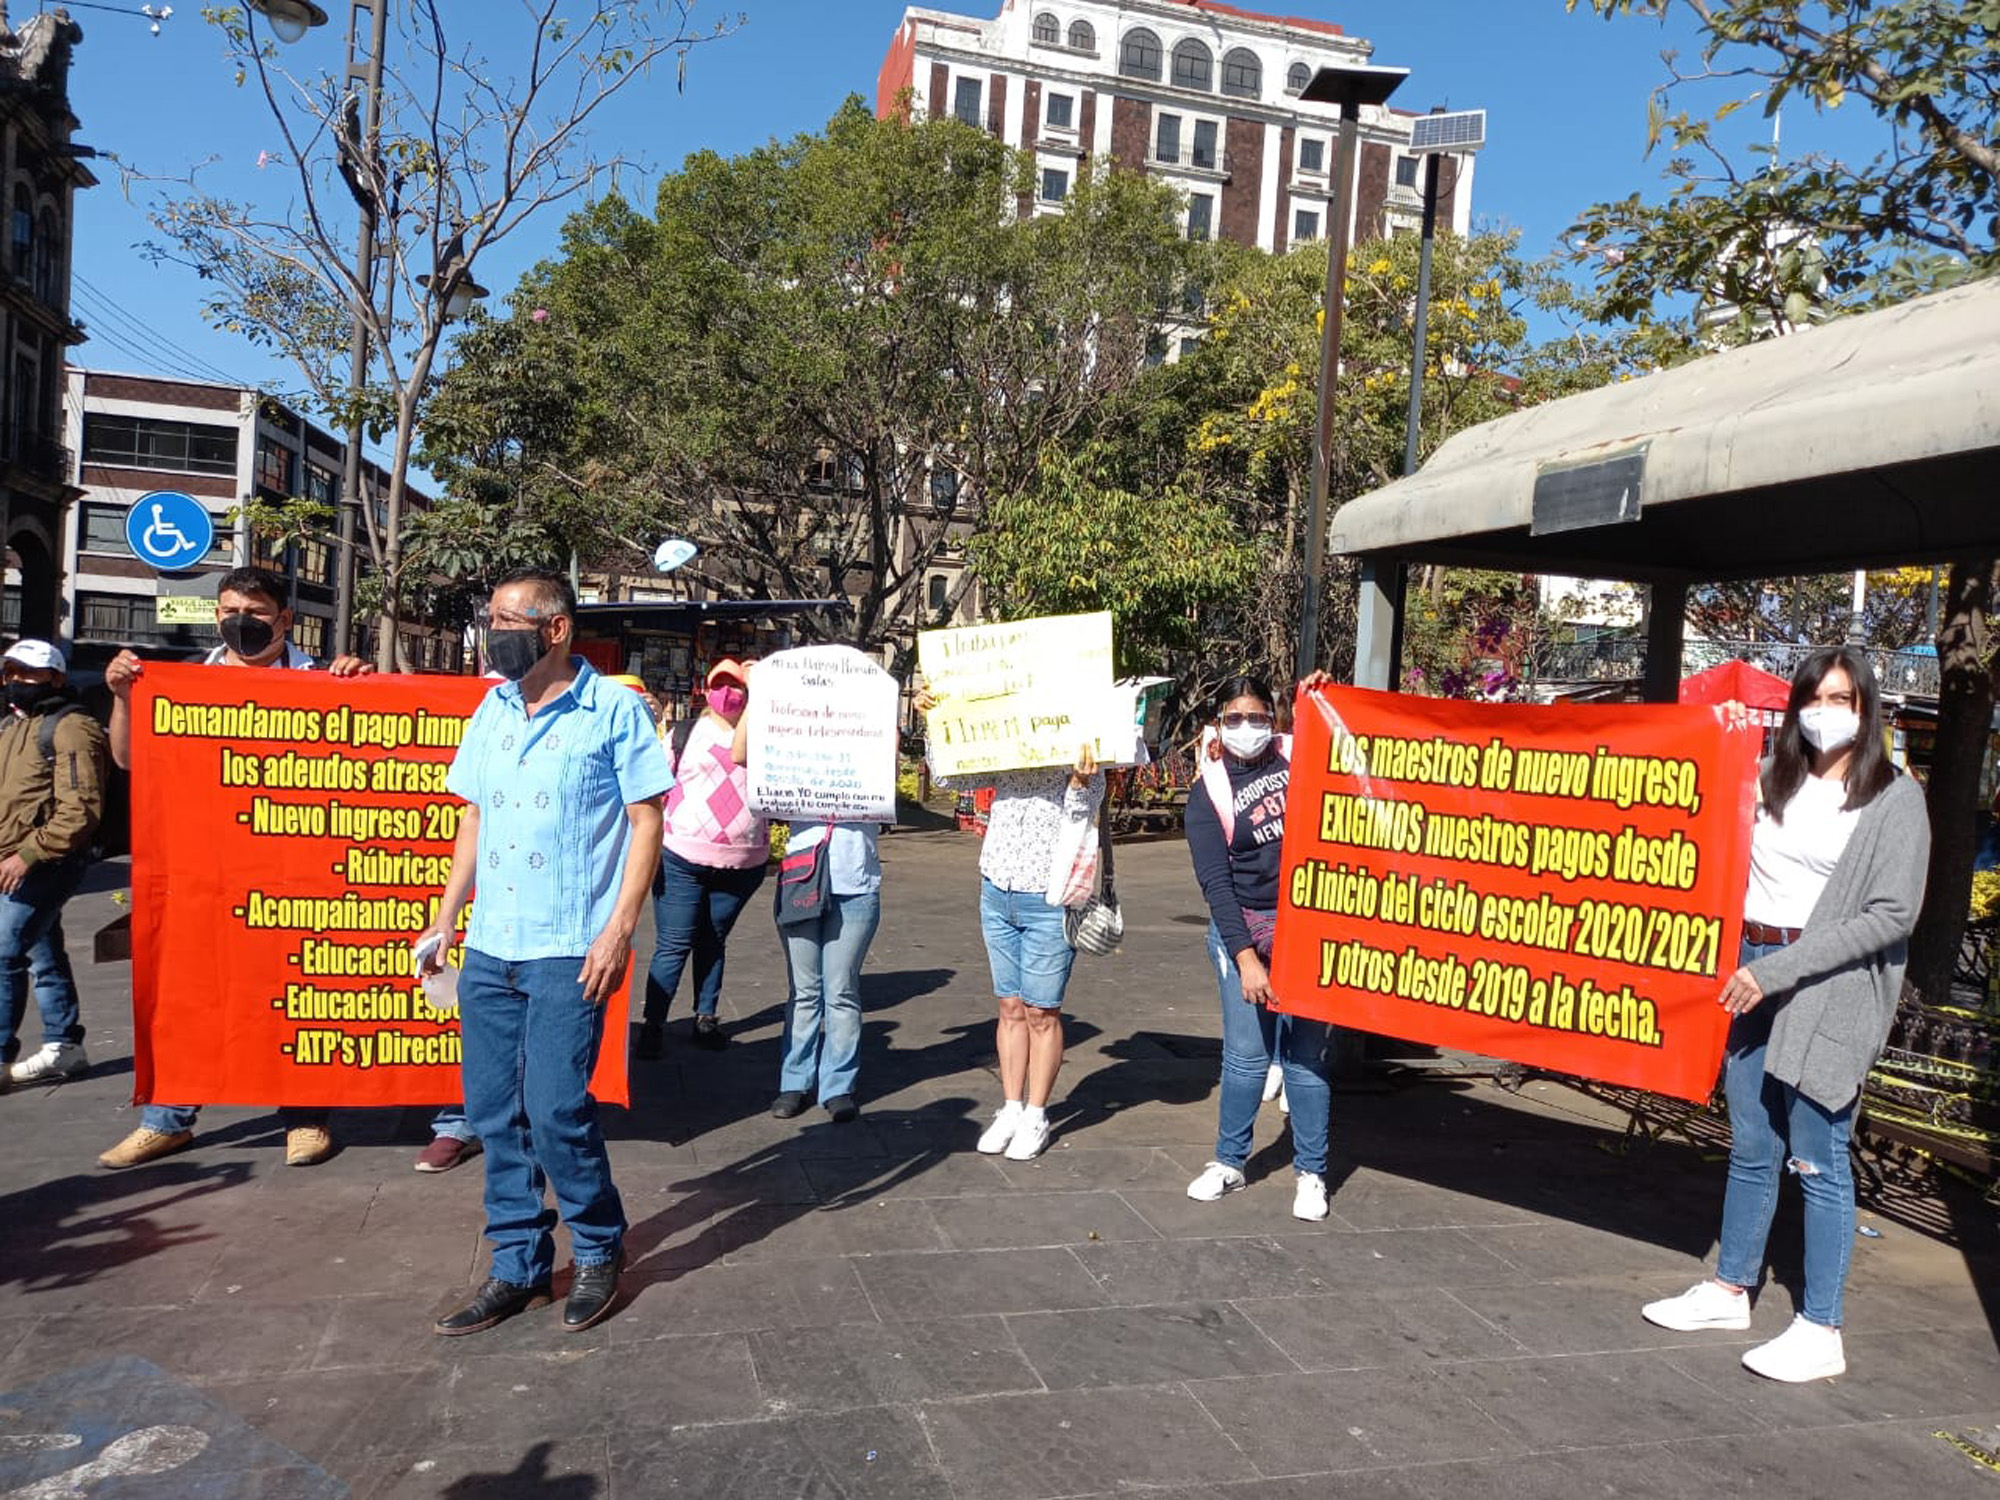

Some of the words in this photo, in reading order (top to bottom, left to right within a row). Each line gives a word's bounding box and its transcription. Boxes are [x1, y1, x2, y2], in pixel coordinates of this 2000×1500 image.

[154, 698, 320, 741] Demandamos
[325, 706, 349, 742] el
[352, 712, 412, 748] pago
[1029, 713, 1071, 733] paga
[223, 749, 260, 786] los
[264, 752, 367, 790] adeudos
[1329, 726, 1369, 776] Los
[1370, 737, 1479, 787] maestros
[1480, 738, 1513, 790] de
[1514, 750, 1590, 797] nuevo
[1592, 746, 1700, 813] ingreso,
[253, 798, 325, 836] Nuevo
[330, 801, 421, 841] ingreso
[1263, 790, 1287, 817] 87
[1252, 818, 1285, 845] NEW
[1321, 792, 1424, 853] EXIGIMOS
[1424, 812, 1530, 867] nuestros
[1532, 826, 1611, 882] pagos
[1613, 826, 1696, 889] desde
[348, 848, 451, 884] Rúbricas
[248, 892, 425, 932] Acompañantes
[1292, 861, 1315, 907] el
[1315, 862, 1378, 918] inicio
[1380, 873, 1419, 924] del
[1419, 880, 1478, 935] ciclo
[1480, 894, 1575, 951] escolar
[1574, 900, 1721, 975] 2020/2021
[287, 985, 408, 1020] Educación
[1320, 941, 1336, 986] y
[1337, 941, 1395, 994] otros
[1396, 948, 1466, 1008] desde
[1467, 959, 1528, 1021] 2019
[1528, 979, 1547, 1026] a
[1548, 975, 1575, 1029] la
[1578, 981, 1661, 1045] fecha.
[296, 1030, 355, 1064] ATP's
[359, 1036, 373, 1067] y
